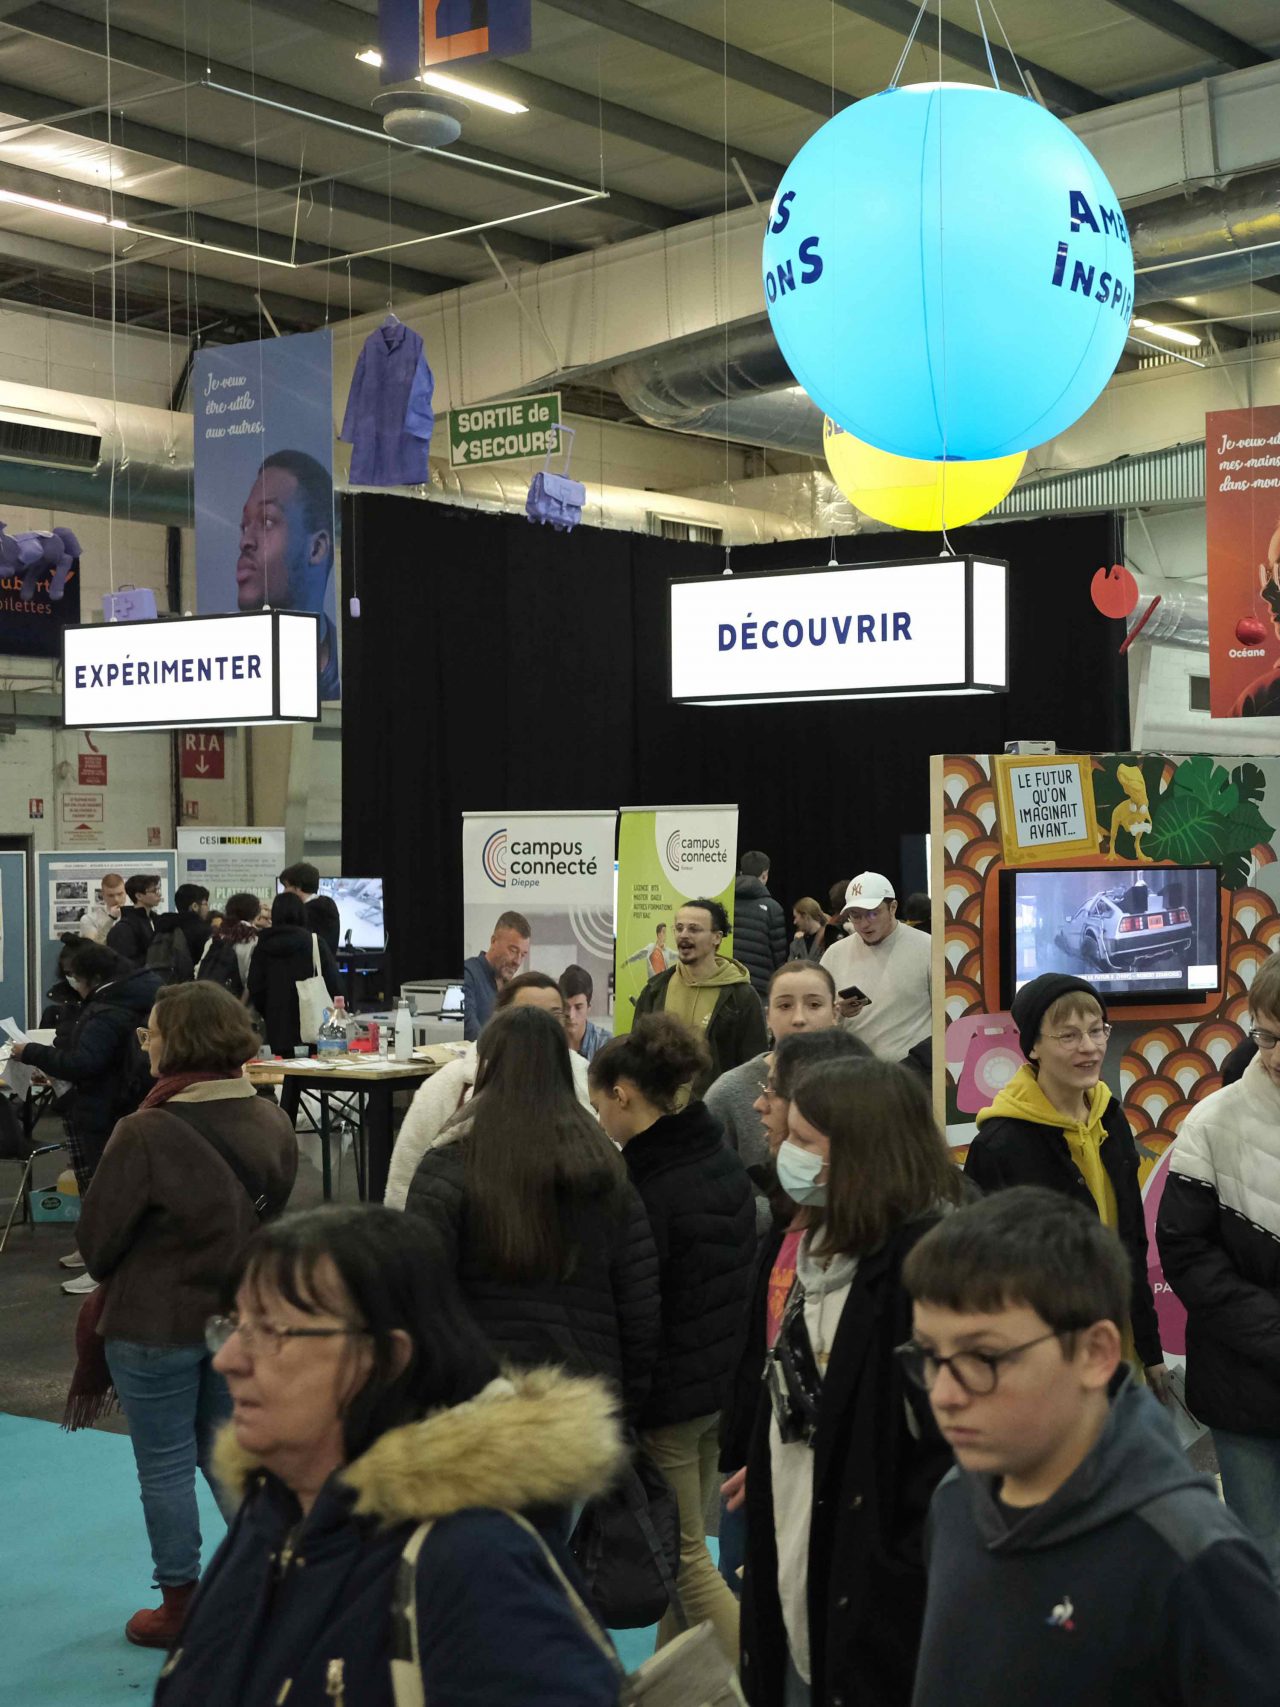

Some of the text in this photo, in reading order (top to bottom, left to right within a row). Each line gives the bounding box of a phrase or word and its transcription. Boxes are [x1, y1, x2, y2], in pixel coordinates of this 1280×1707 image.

[204, 372, 246, 396] Je veux
[206, 391, 255, 415] être utile
[458, 403, 549, 433] SORTIE de
[206, 427, 226, 439] aux
[469, 430, 558, 460] SECOURS
[1217, 434, 1236, 455] Je
[1236, 438, 1266, 448] veux
[1219, 460, 1243, 471] mes
[1219, 475, 1250, 492] dans
[1251, 478, 1280, 488] mon
[718, 612, 912, 651] DÉCOUVRIR
[1228, 647, 1266, 658] Océane
[75, 654, 262, 688] EXPÉRIMENTER
[185, 733, 220, 751] RIA
[1018, 769, 1073, 788] LE FUTUR
[1032, 787, 1067, 807] QU'ON
[1020, 803, 1077, 823] IMAGINAIT
[200, 836, 219, 845] CESI
[681, 839, 720, 851] campus
[510, 842, 583, 860] campus
[681, 849, 727, 863] connecté
[510, 856, 597, 875] connecté
[511, 878, 540, 888] Dieppe
